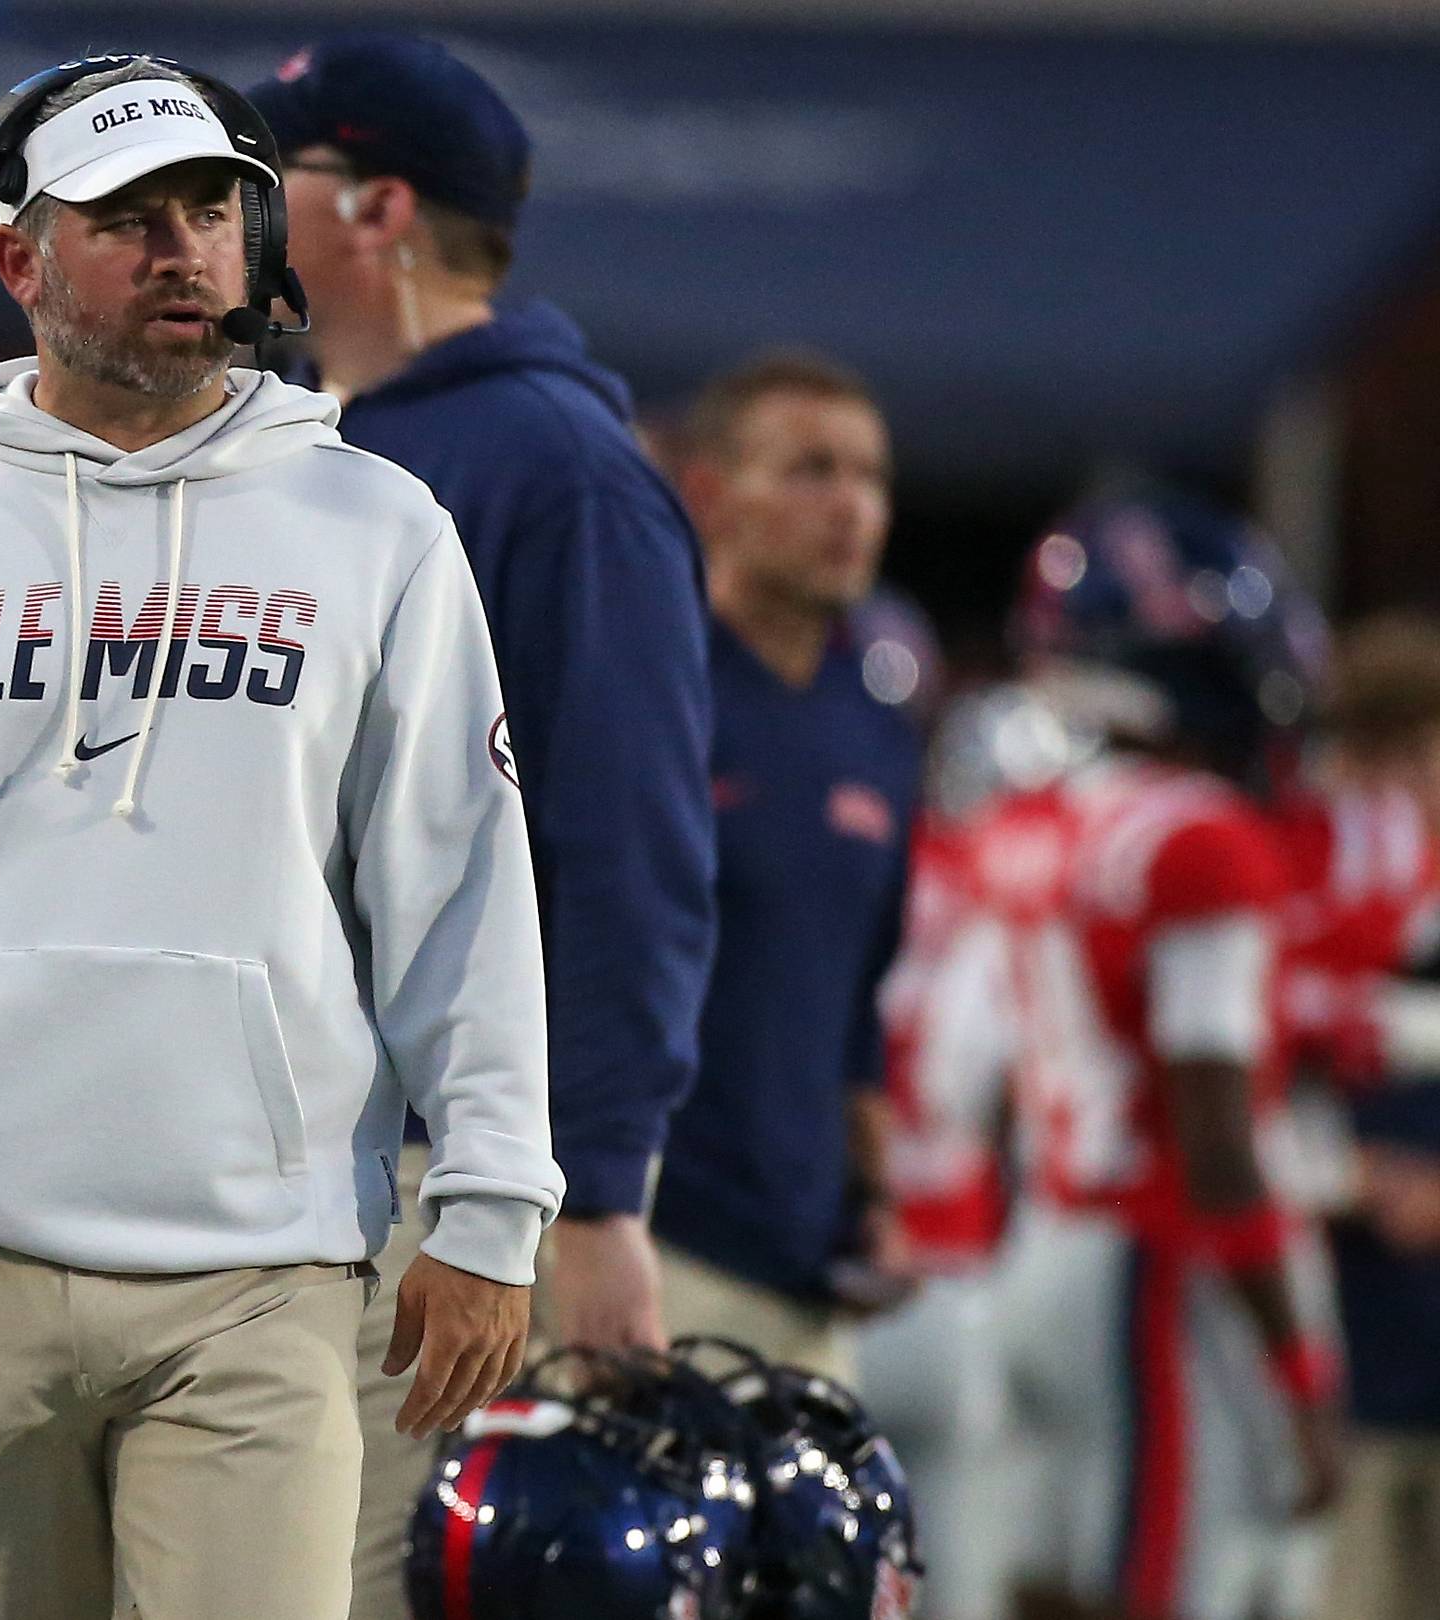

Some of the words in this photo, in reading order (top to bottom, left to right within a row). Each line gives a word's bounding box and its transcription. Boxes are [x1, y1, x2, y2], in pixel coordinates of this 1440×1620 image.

[91, 101, 143, 134] OLE
[147, 98, 206, 121] MISS
[79, 579, 319, 707] MISS
